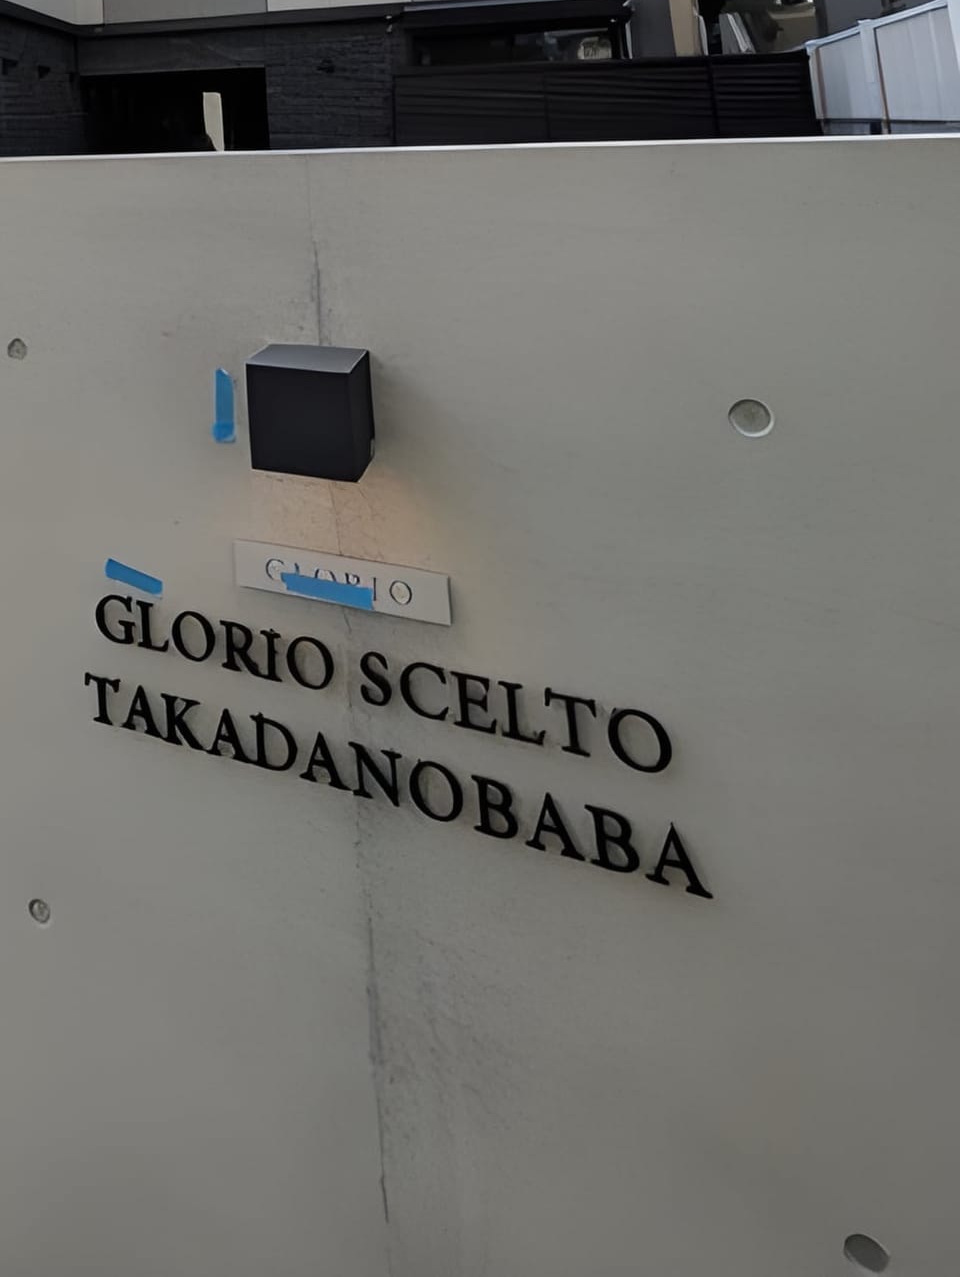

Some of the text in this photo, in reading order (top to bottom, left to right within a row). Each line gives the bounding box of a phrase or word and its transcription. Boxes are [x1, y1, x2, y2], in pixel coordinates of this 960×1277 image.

[84, 672, 714, 900] TAKADANOBABA
[95, 594, 673, 774] GLORIO SCELTO
